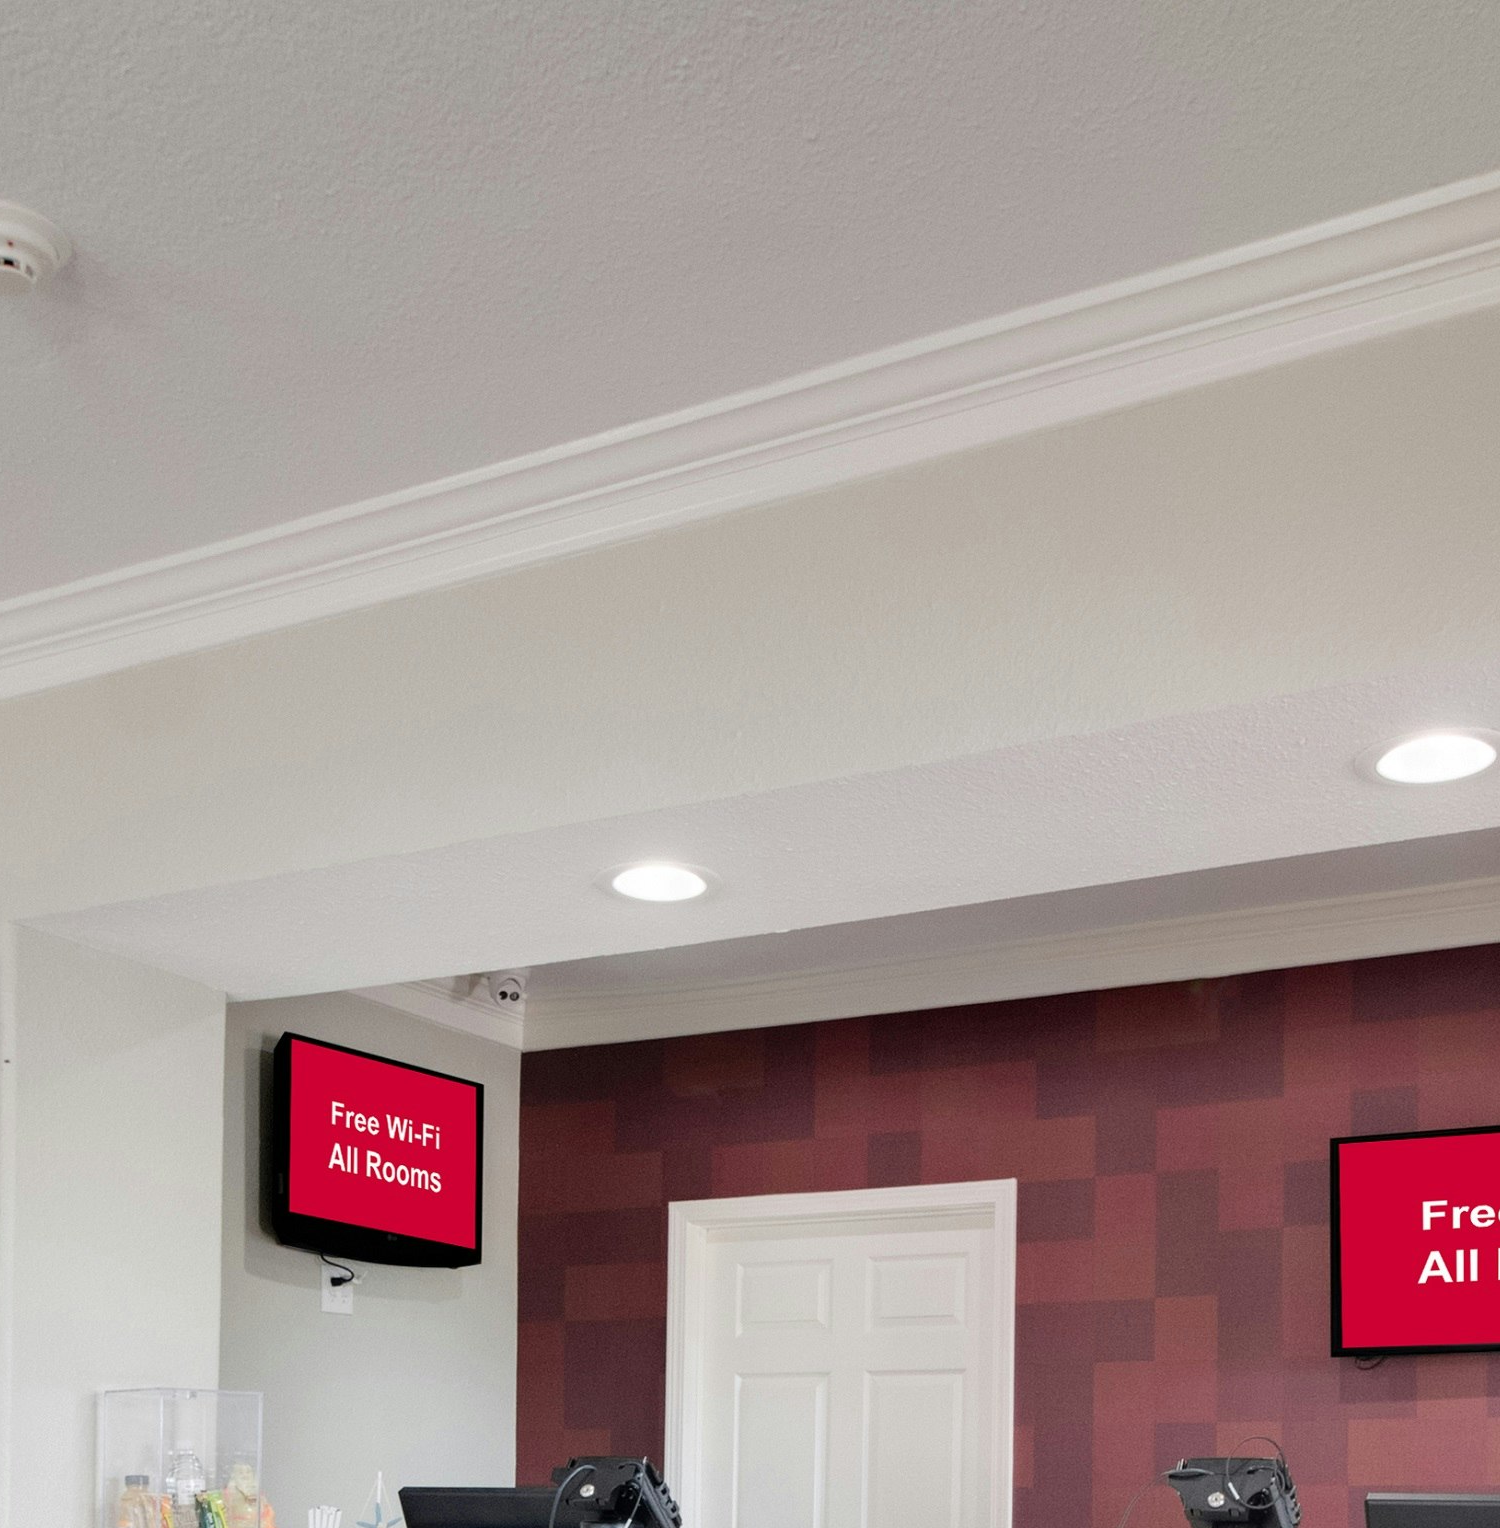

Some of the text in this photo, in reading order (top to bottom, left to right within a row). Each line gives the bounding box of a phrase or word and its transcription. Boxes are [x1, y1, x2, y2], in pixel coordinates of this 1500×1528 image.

[331, 1100, 441, 1150] Free Wi-Fi
[328, 1142, 442, 1194] All Rooms
[1417, 1249, 1479, 1285] All
